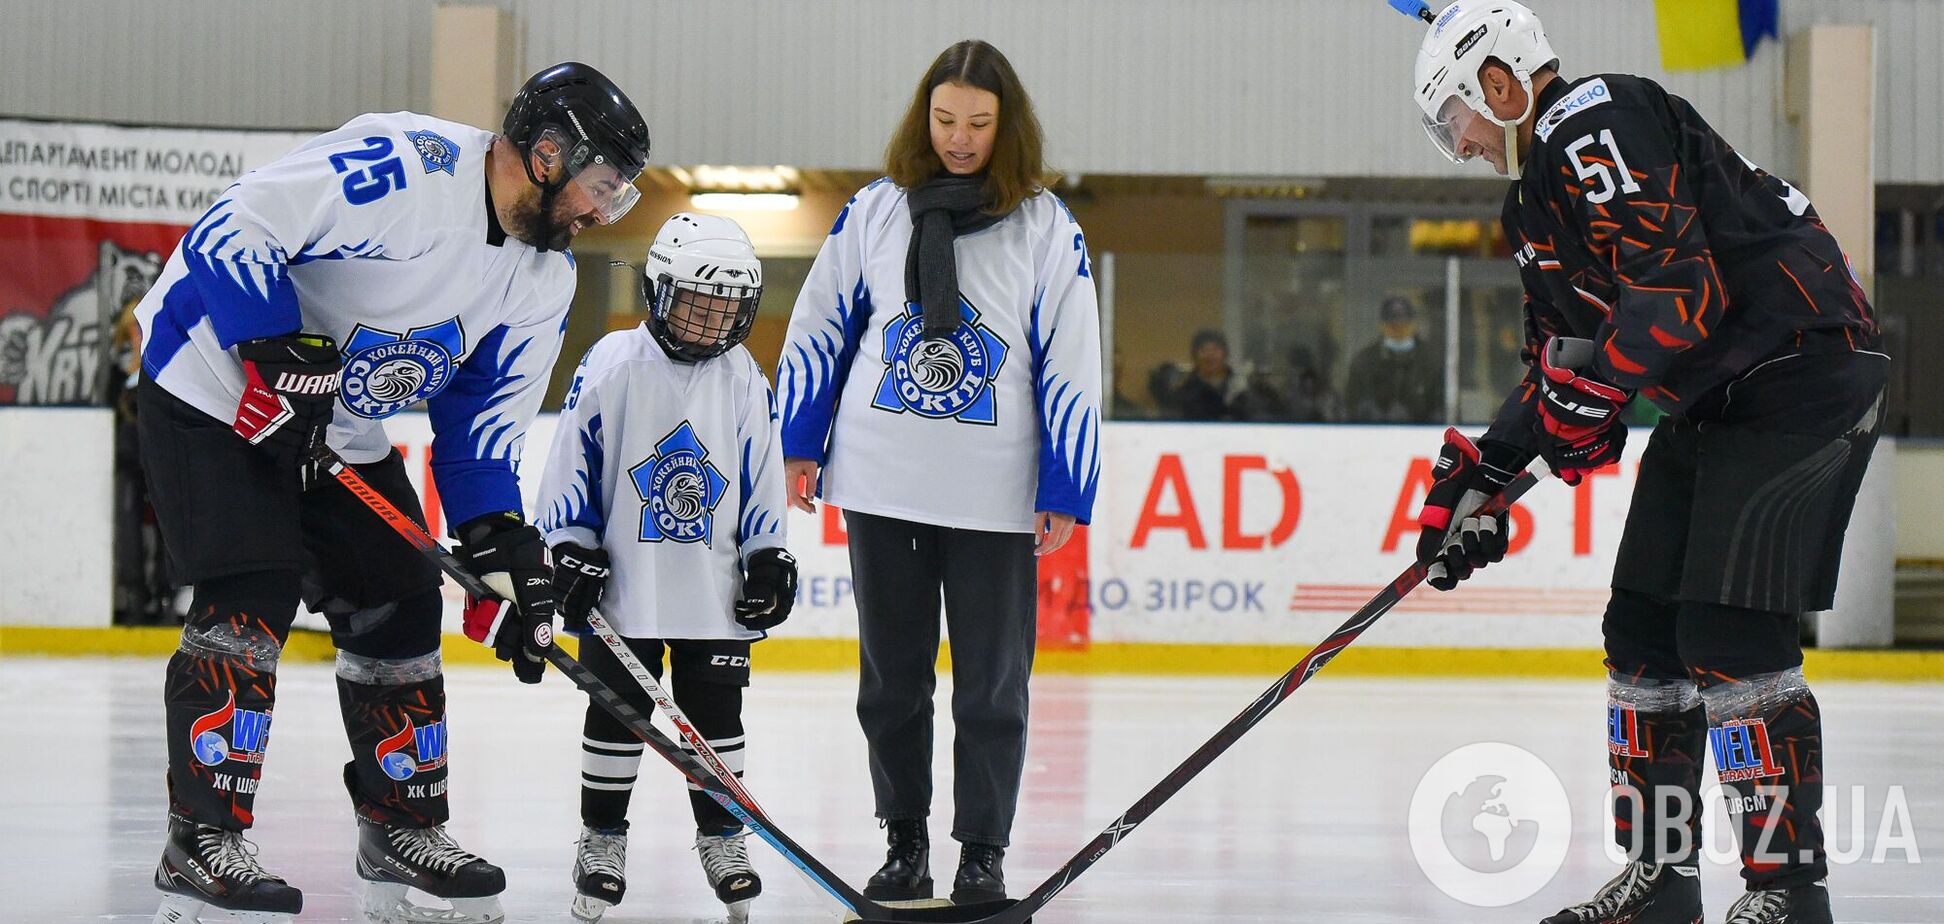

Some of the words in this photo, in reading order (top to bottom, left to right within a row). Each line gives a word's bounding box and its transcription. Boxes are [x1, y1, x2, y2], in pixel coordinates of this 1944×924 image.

[1456, 27, 1486, 57] BAUER
[0, 140, 137, 172] ЕПАРТАМЕНТ
[145, 150, 243, 177] МОЛОДІ
[328, 136, 407, 206] 25
[1564, 129, 1641, 204] 51
[9, 176, 90, 201] СПОРТІ
[100, 182, 169, 208] МІСТА
[1072, 232, 1092, 278] 2
[367, 341, 445, 368] ХОКЕЙНИЙ
[959, 332, 982, 367] КЛУБ
[562, 376, 584, 411] 5
[896, 359, 983, 412] СОКІЛ
[652, 495, 706, 537] СОК
[1130, 453, 1302, 551] AD
[1380, 455, 1622, 557] AT
[1145, 578, 1265, 613] ЗІРОК
[212, 772, 232, 791] ХК
[407, 784, 425, 798] ХК
[186, 857, 214, 885] CCM
[385, 855, 417, 878] CCM
